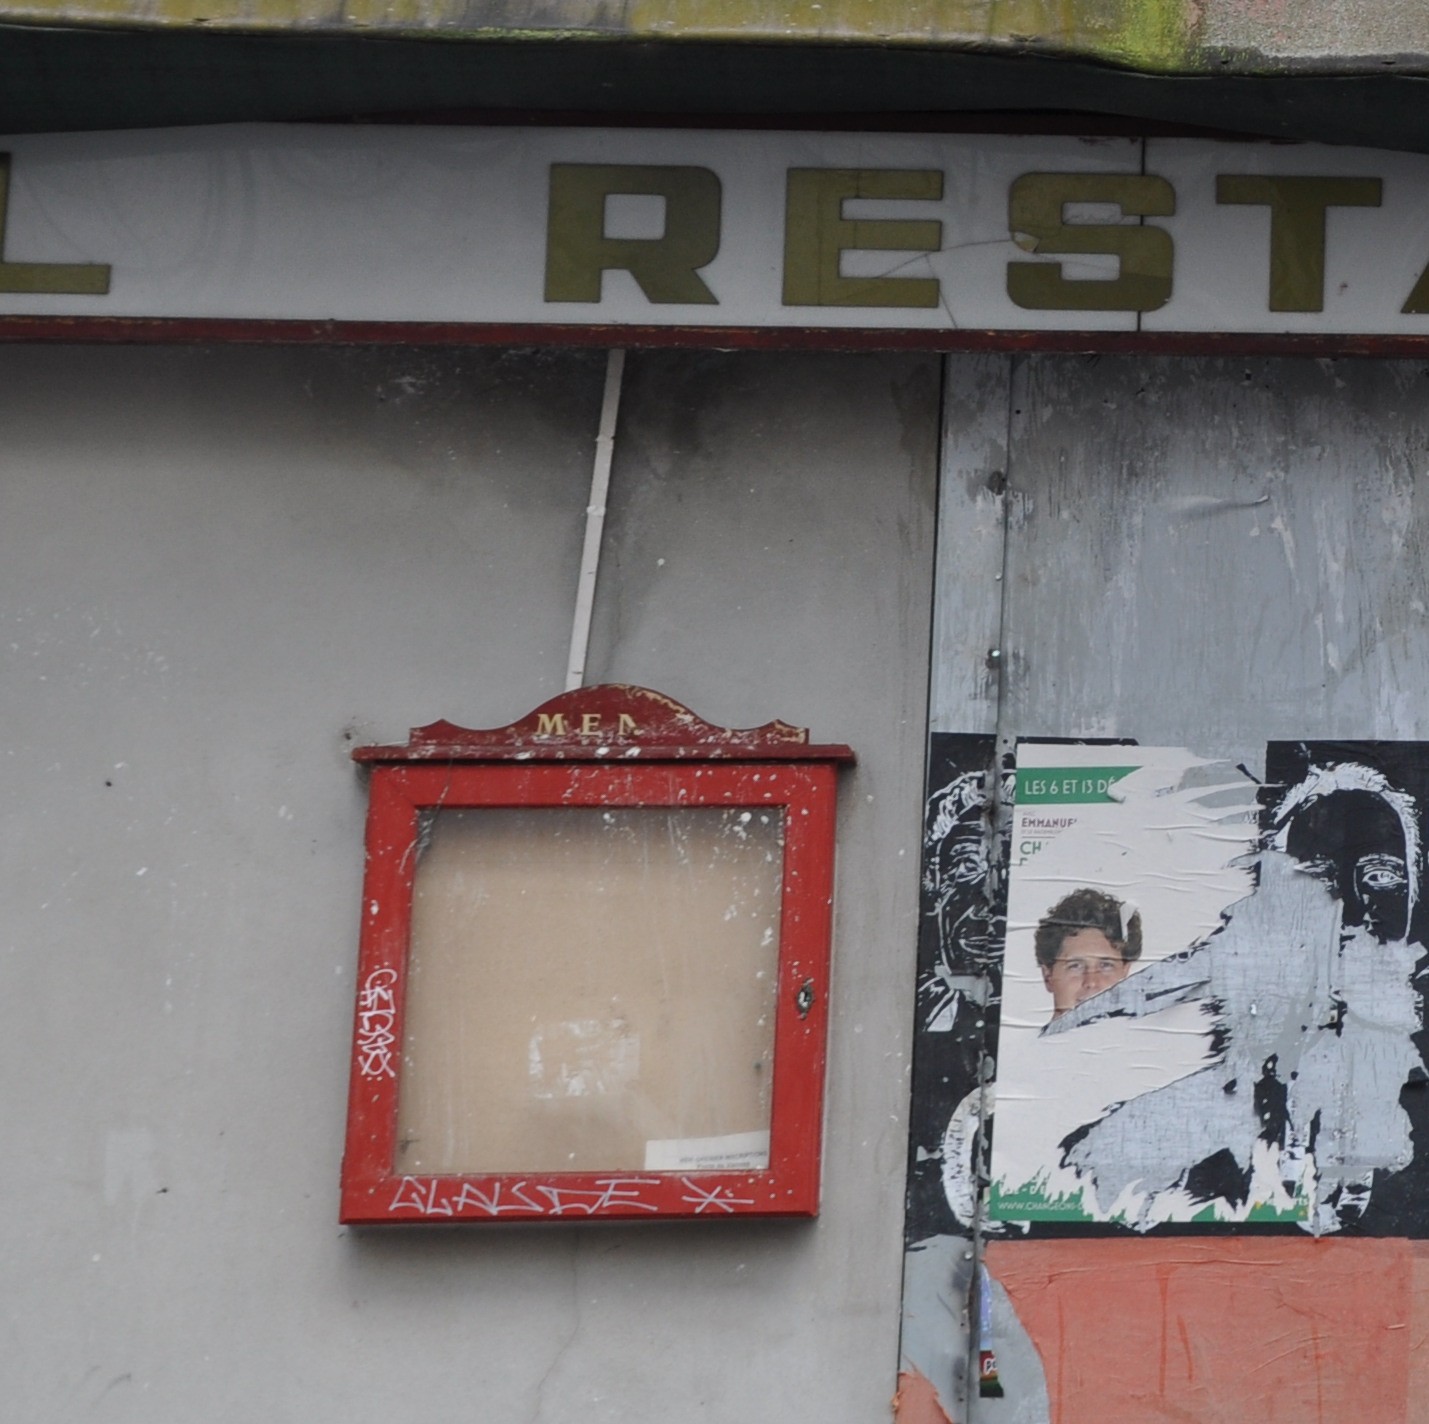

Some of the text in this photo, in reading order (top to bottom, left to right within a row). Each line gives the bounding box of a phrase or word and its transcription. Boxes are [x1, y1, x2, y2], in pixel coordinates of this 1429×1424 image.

[1024, 779, 1046, 795] LES
[1050, 779, 1058, 795] 6
[1062, 779, 1078, 794] ET
[1082, 779, 1093, 794] 13
[1021, 816, 1078, 828] EMMANUE
